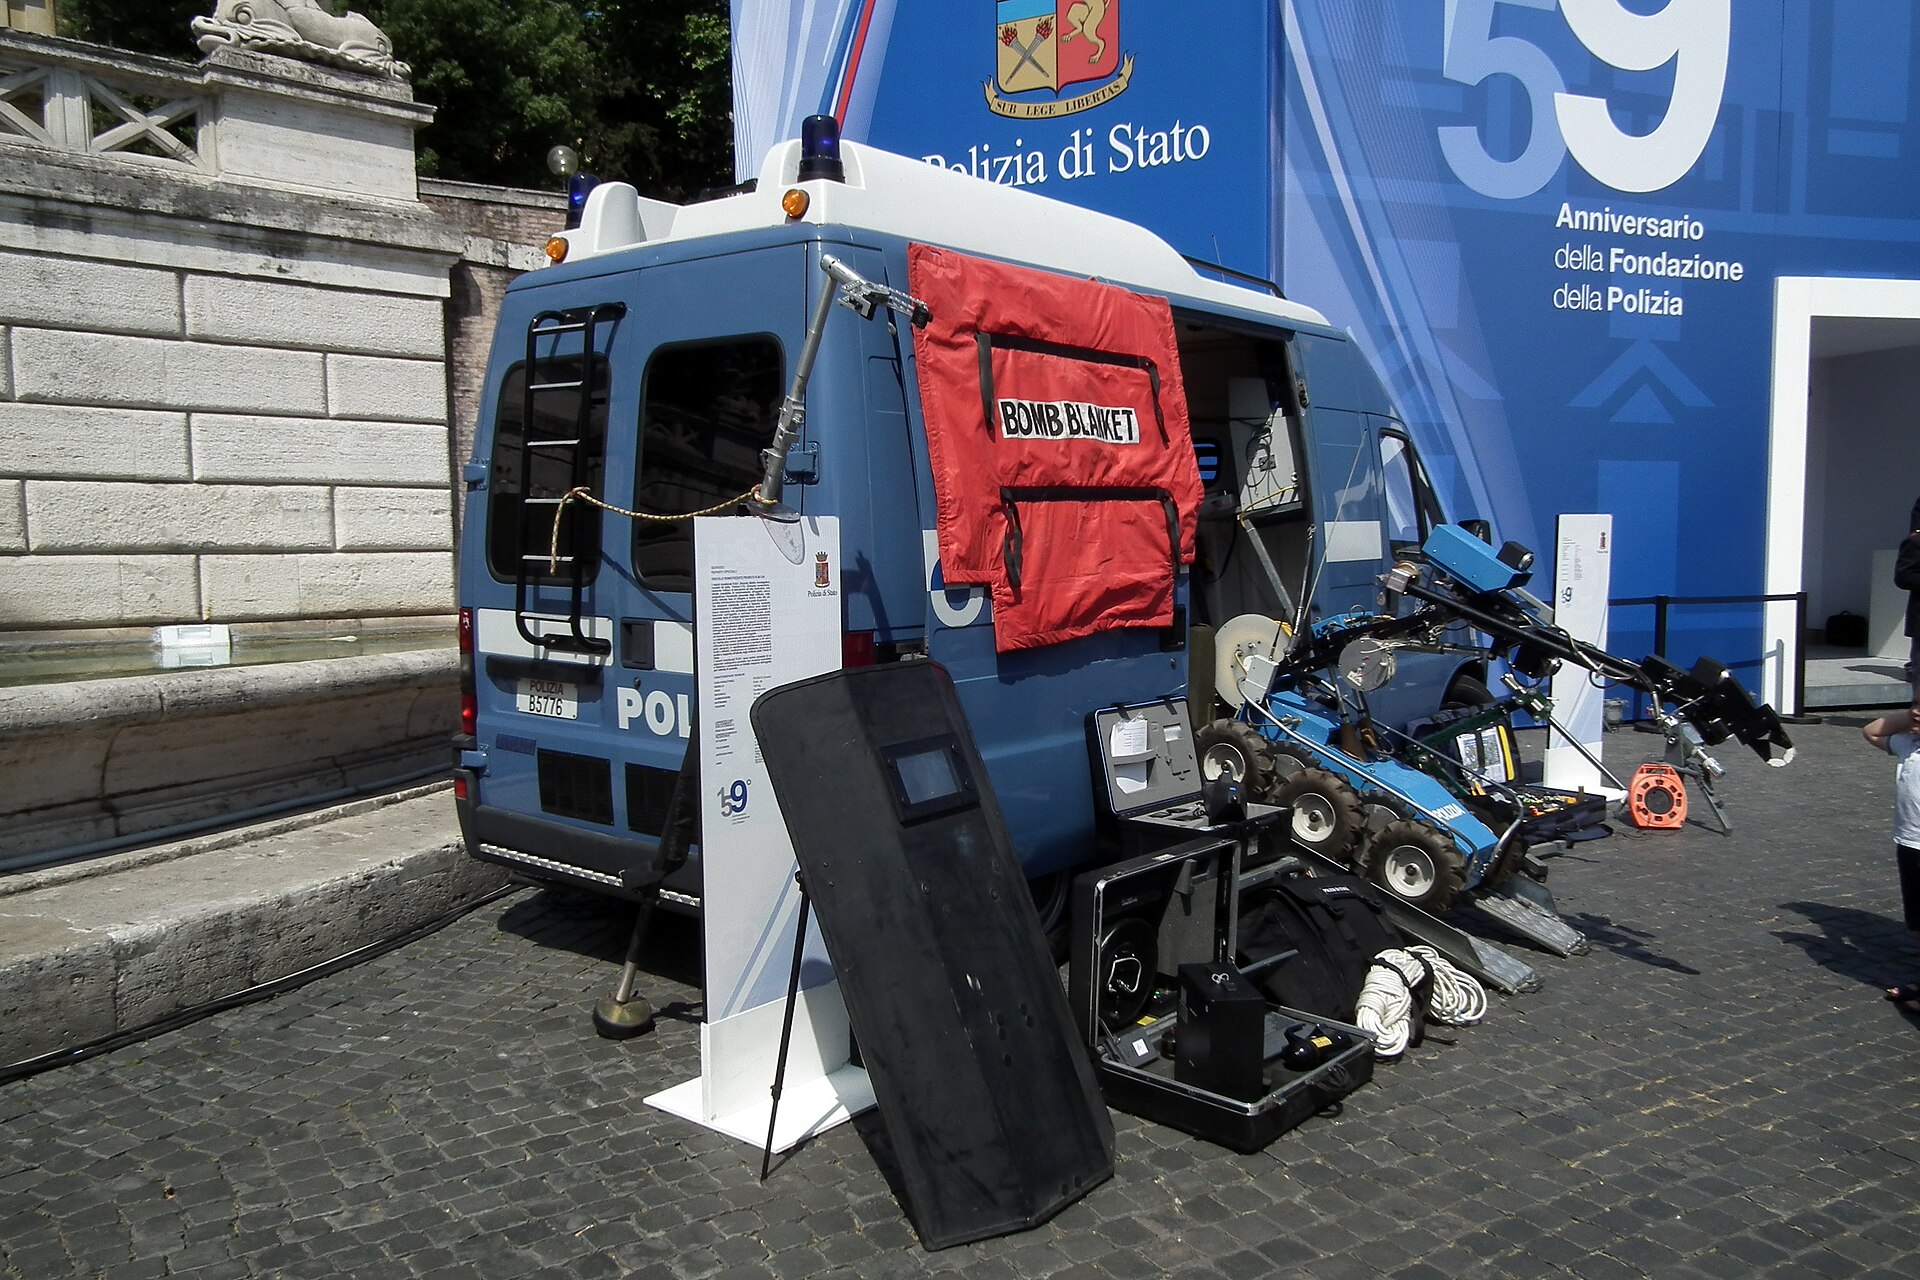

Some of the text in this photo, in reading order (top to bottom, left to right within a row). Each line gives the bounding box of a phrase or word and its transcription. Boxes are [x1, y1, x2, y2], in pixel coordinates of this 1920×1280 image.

[994, 83, 1121, 116] SUB LEGE LIBERTAS
[1058, 128, 1096, 180] di
[1108, 119, 1211, 174] Stato
[1555, 203, 1704, 241] Anniversario
[1554, 243, 1744, 282] della Fondazione
[1553, 283, 1683, 316] della Polizia
[1000, 401, 1064, 437] BOMB
[529, 680, 564, 696] POLIZIA
[528, 695, 563, 716] B5776
